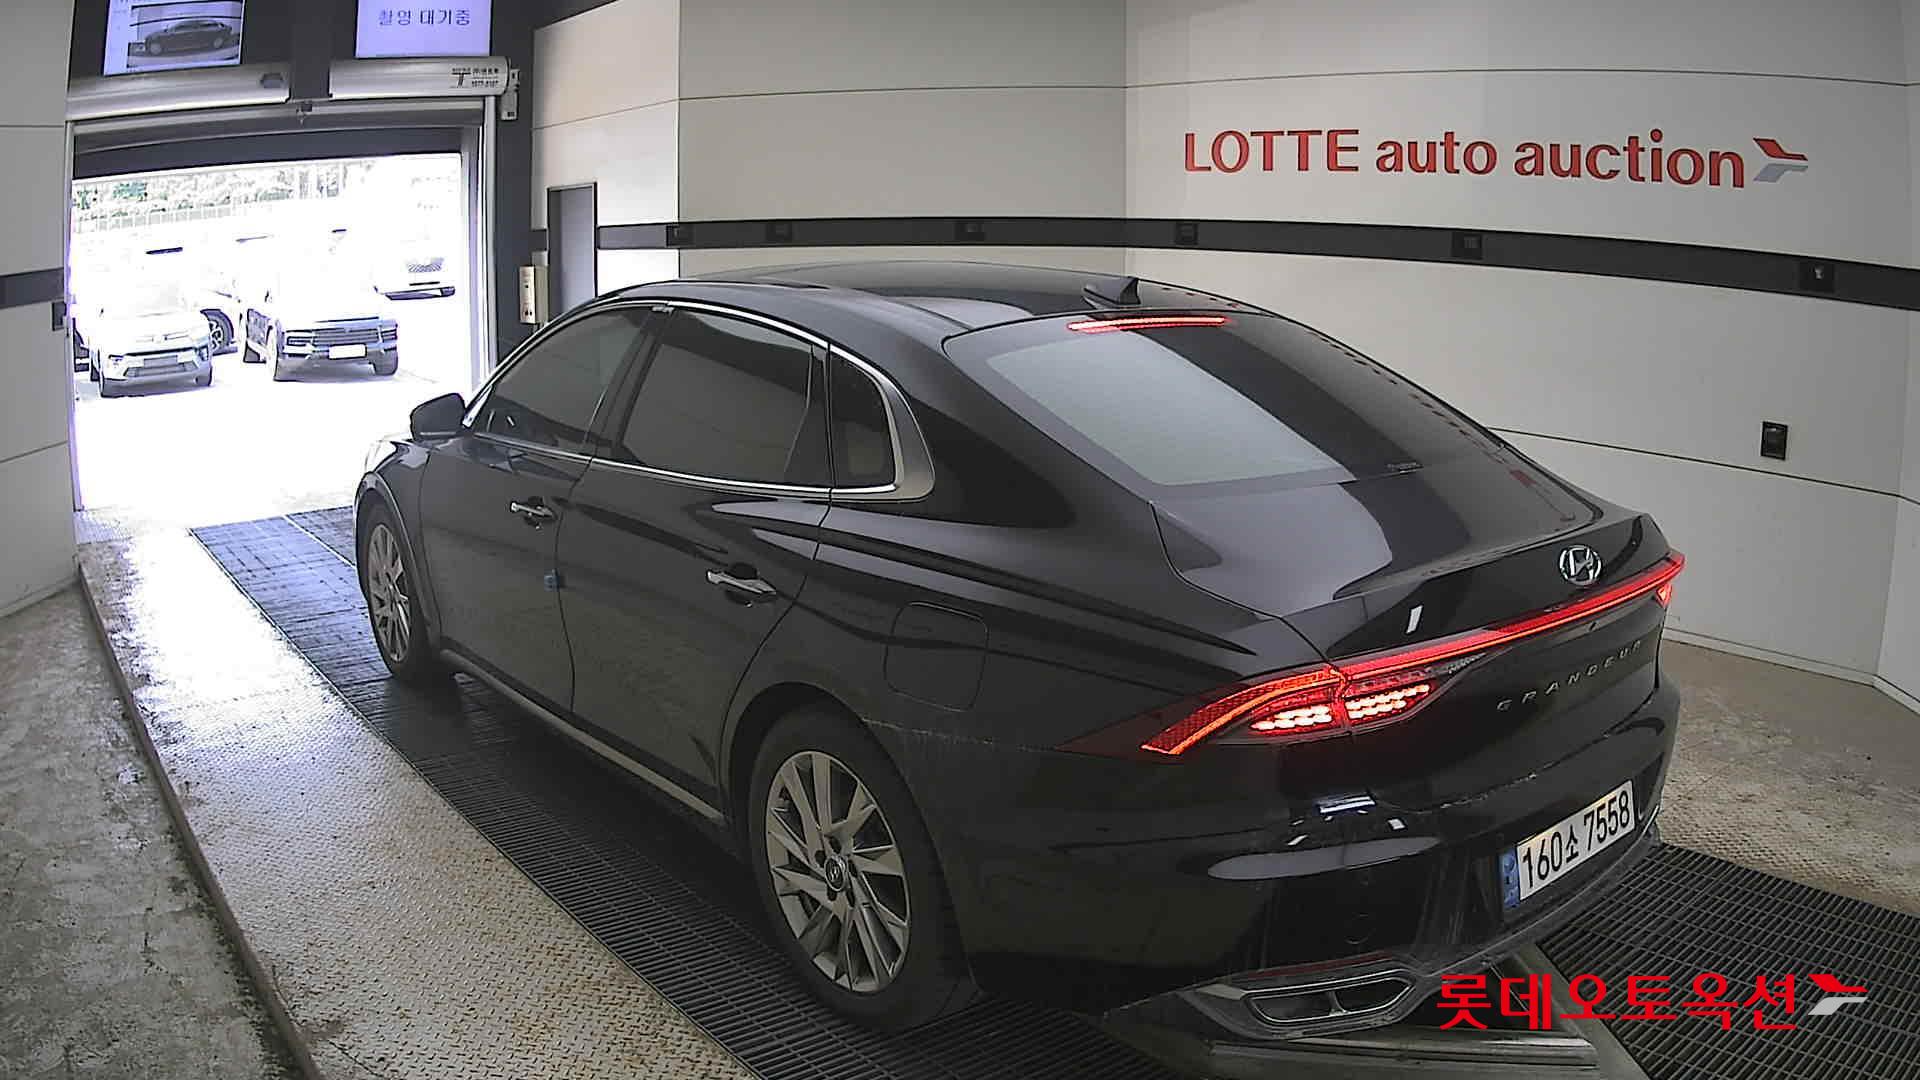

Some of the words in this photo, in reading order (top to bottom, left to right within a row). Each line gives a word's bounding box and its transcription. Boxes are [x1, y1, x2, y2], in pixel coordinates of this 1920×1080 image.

[419, 9, 470, 26] 대기중
[1184, 130, 1359, 173] LOTTE
[1376, 130, 1498, 175] auto
[1514, 129, 1744, 188] auction
[1497, 639, 1641, 711] GRANDEUR
[1522, 825, 1579, 889] 160소
[1583, 790, 1631, 852] 7558
